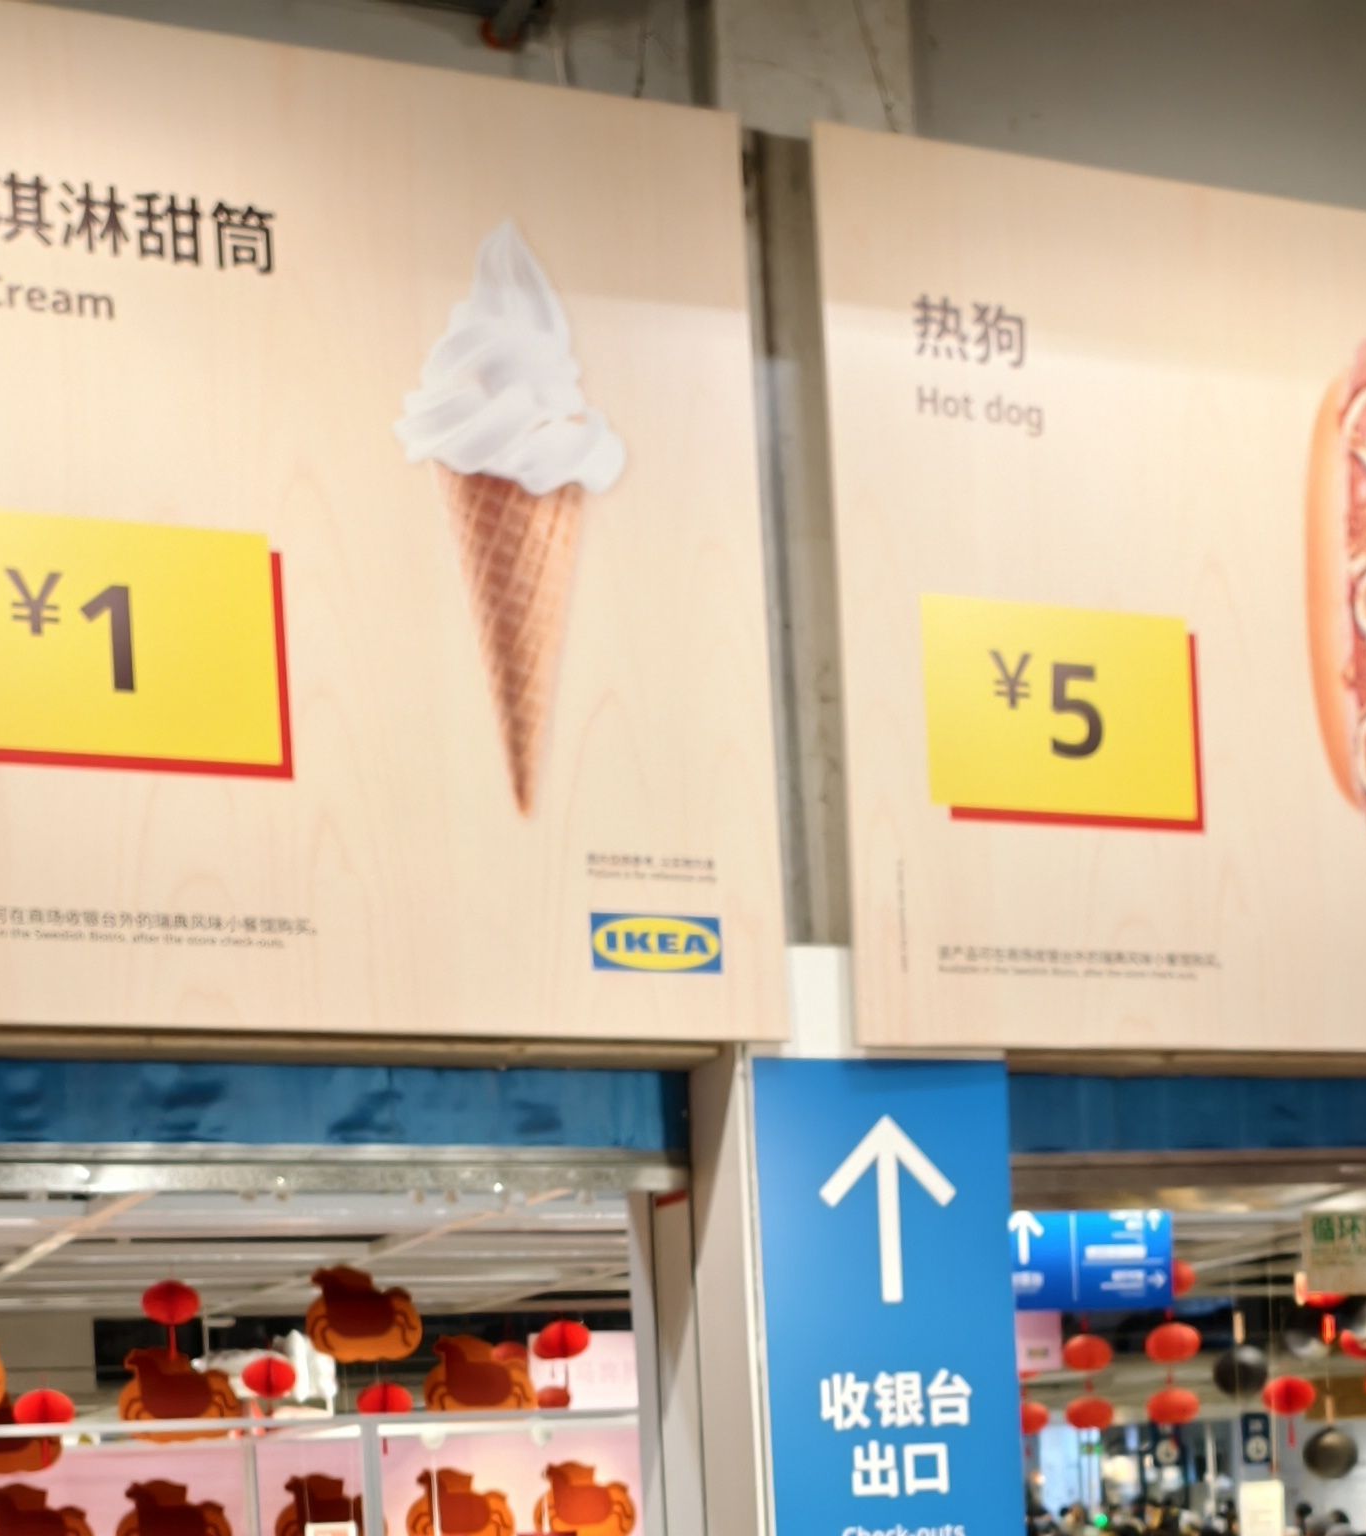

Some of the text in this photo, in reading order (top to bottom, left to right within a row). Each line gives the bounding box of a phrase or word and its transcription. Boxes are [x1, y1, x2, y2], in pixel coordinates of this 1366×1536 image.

[912, 294, 1026, 370] 热狗
[916, 386, 1045, 438] Hot dog
[4, 566, 136, 694] ¥1
[990, 649, 1106, 760] ¥5
[605, 931, 711, 955] IKEA
[819, 1368, 973, 1431] 收银台
[851, 1440, 951, 1498] 出口
